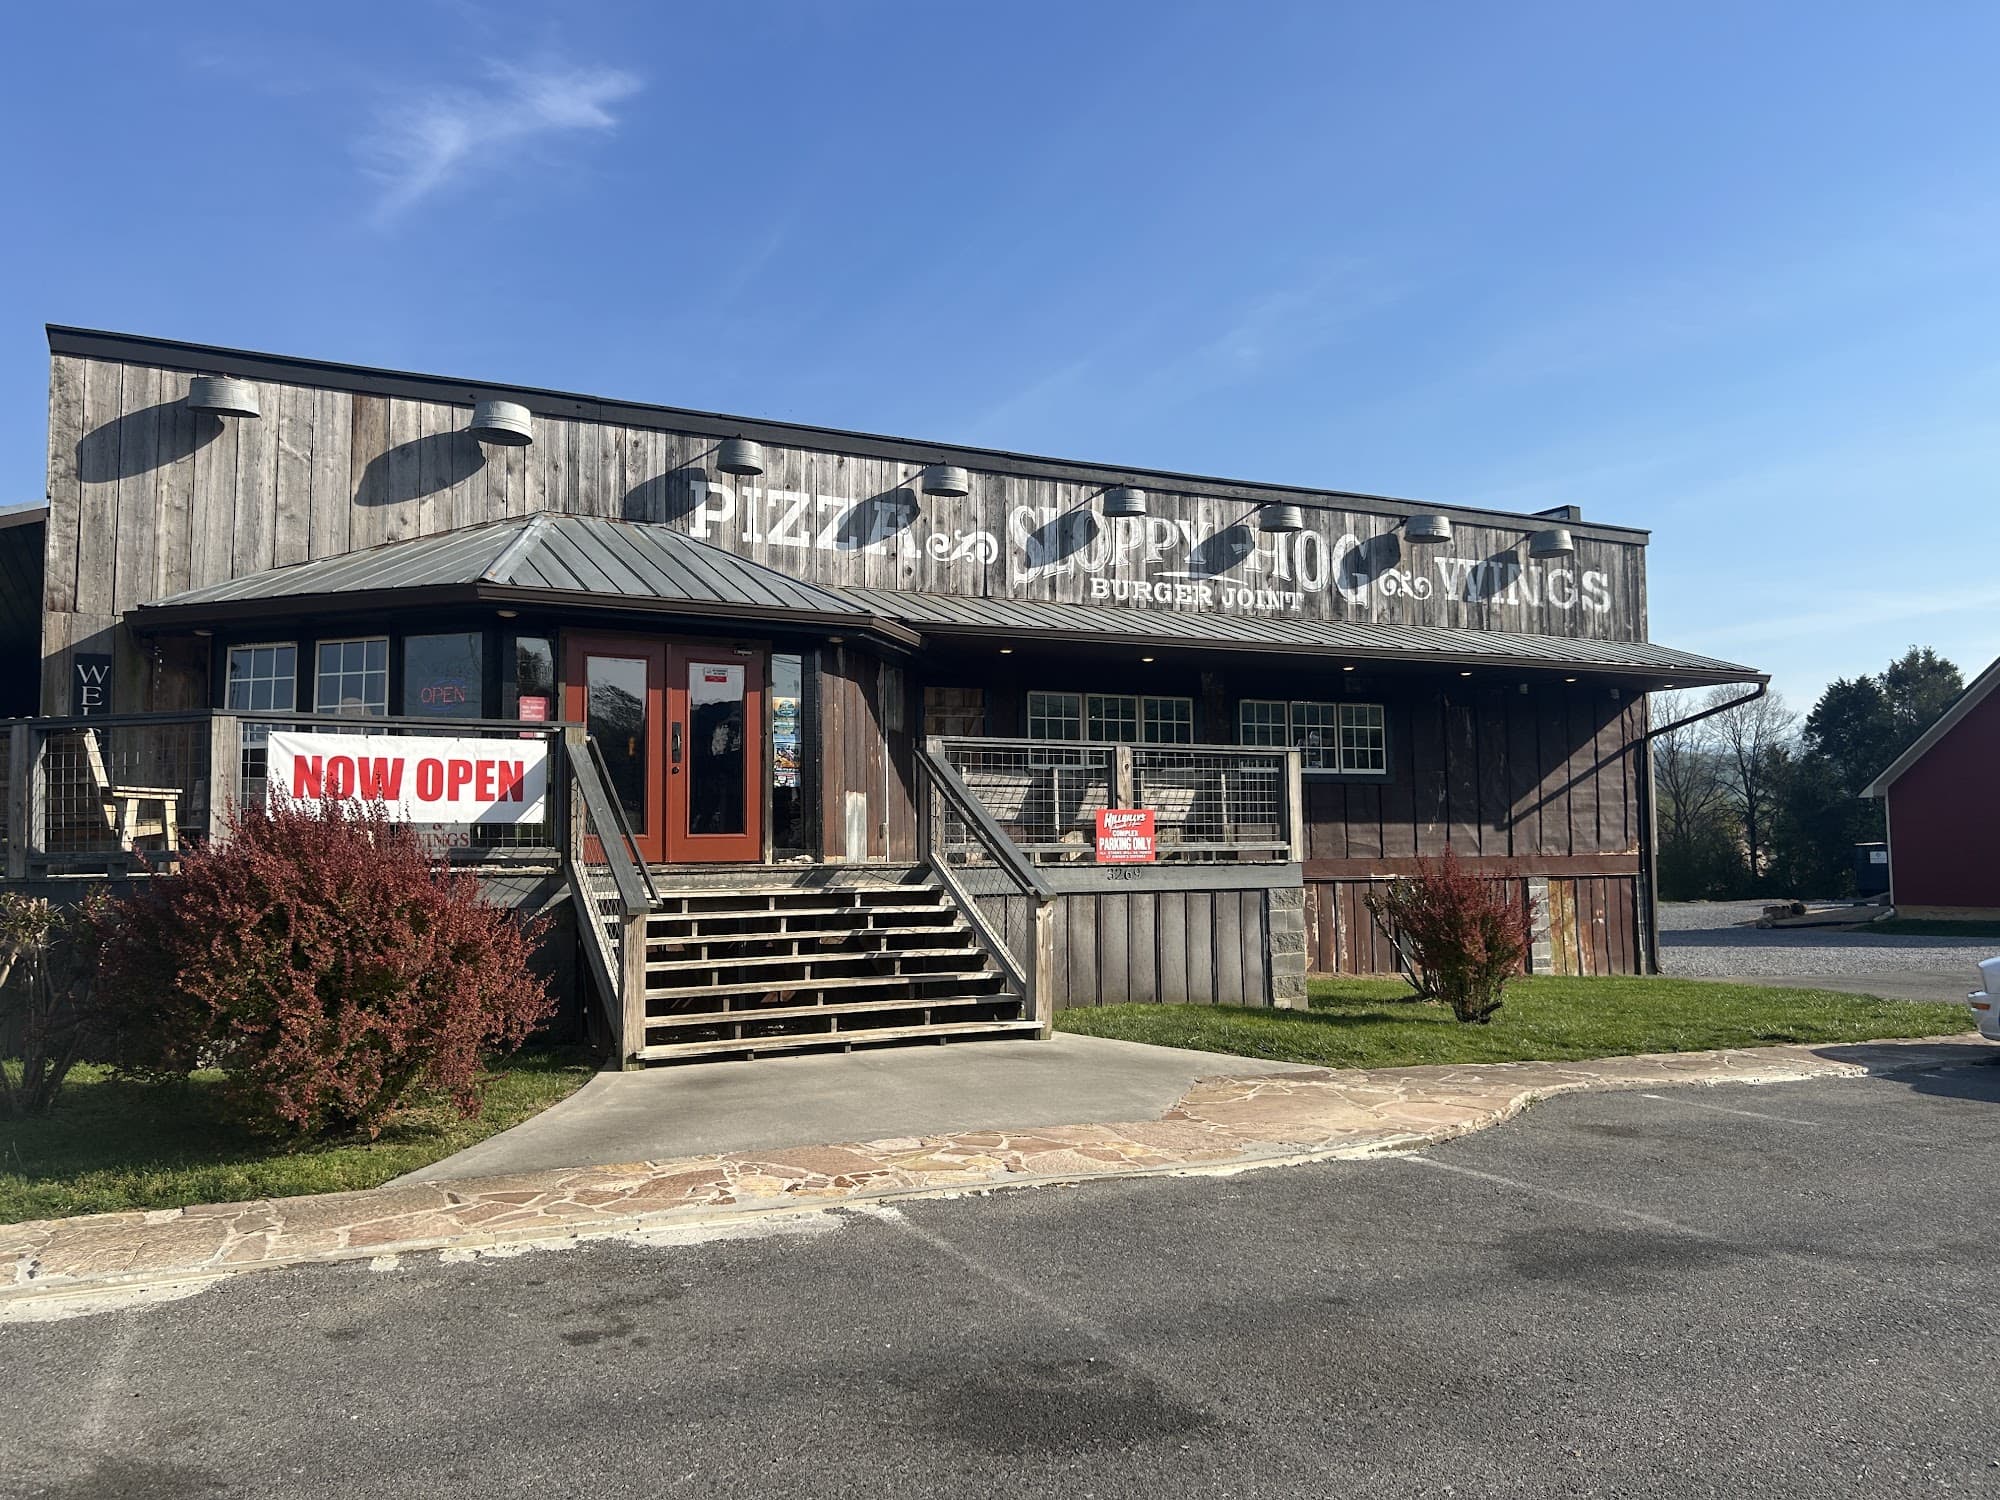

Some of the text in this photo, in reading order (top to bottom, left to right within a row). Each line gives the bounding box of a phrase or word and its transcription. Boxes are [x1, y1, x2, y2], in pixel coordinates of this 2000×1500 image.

[689, 481, 921, 558] PIZZA
[1009, 505, 1368, 609] SLOPPY HOG
[1090, 578, 1304, 611] BURGER JOINT
[1434, 556, 1611, 613] WINGS
[421, 687, 465, 704] OPEN
[292, 755, 524, 803] NOW OPEN
[1099, 836, 1152, 851] PARKING ONLY
[1112, 829, 1139, 837] COMPLEX
[1106, 866, 1143, 881] 3269
